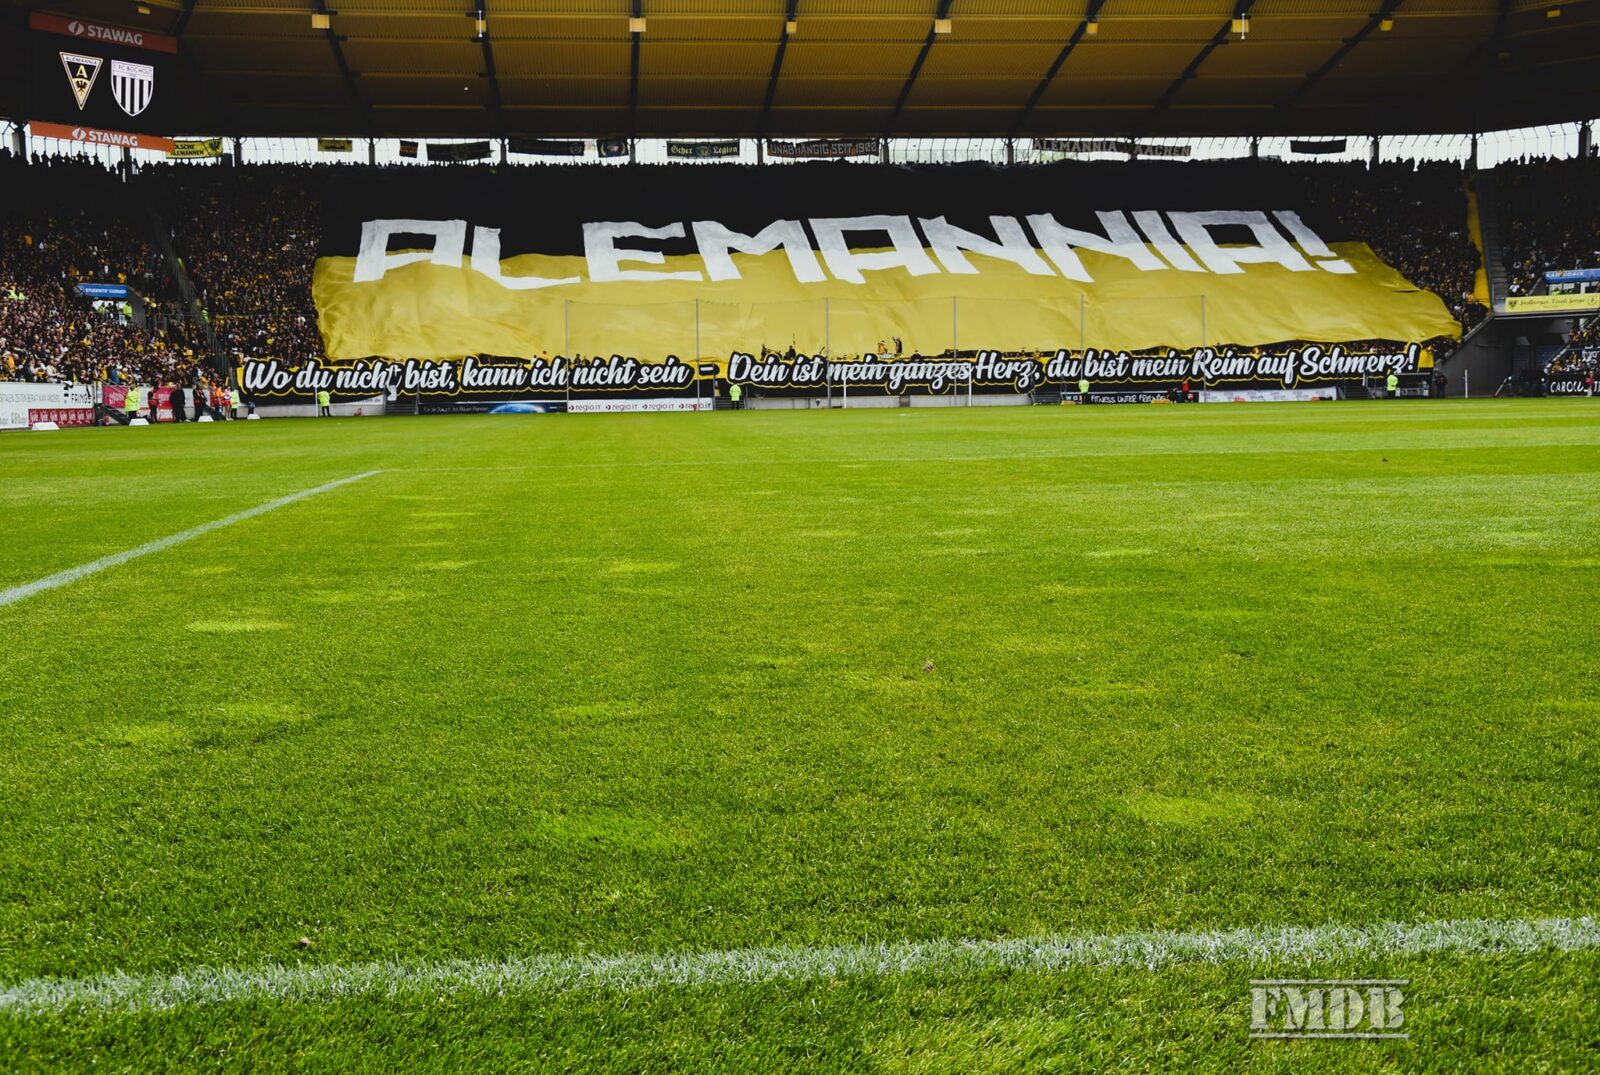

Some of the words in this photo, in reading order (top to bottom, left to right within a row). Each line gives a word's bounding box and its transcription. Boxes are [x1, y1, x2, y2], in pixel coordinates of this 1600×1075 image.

[87, 25, 143, 46] STAWAG
[76, 65, 88, 78] A
[89, 130, 138, 146] STAWAG
[831, 143, 853, 154] SEIT
[1034, 140, 1117, 152] ALEMANNIA
[1134, 144, 1191, 156] AACHEN
[354, 210, 1356, 290] ALEMANNIA!
[245, 361, 294, 389] Wo
[296, 361, 334, 389] du
[336, 361, 402, 389] nicht
[405, 359, 455, 389] bist,
[462, 357, 529, 387] kann
[530, 358, 571, 385] ich
[573, 357, 636, 386] nicht
[637, 356, 690, 385] sein
[729, 354, 791, 382] Dein
[792, 355, 824, 382] ist
[829, 355, 890, 381] mein
[888, 362, 974, 389] ganzes
[975, 351, 1040, 388] Herz,
[1047, 351, 1084, 377] du
[1084, 351, 1129, 377] bist
[1131, 348, 1189, 376] mein
[1192, 348, 1255, 379] Reim
[1258, 351, 1298, 384] auf
[1300, 344, 1417, 376] Schmerz!
[649, 403, 668, 411] regio
